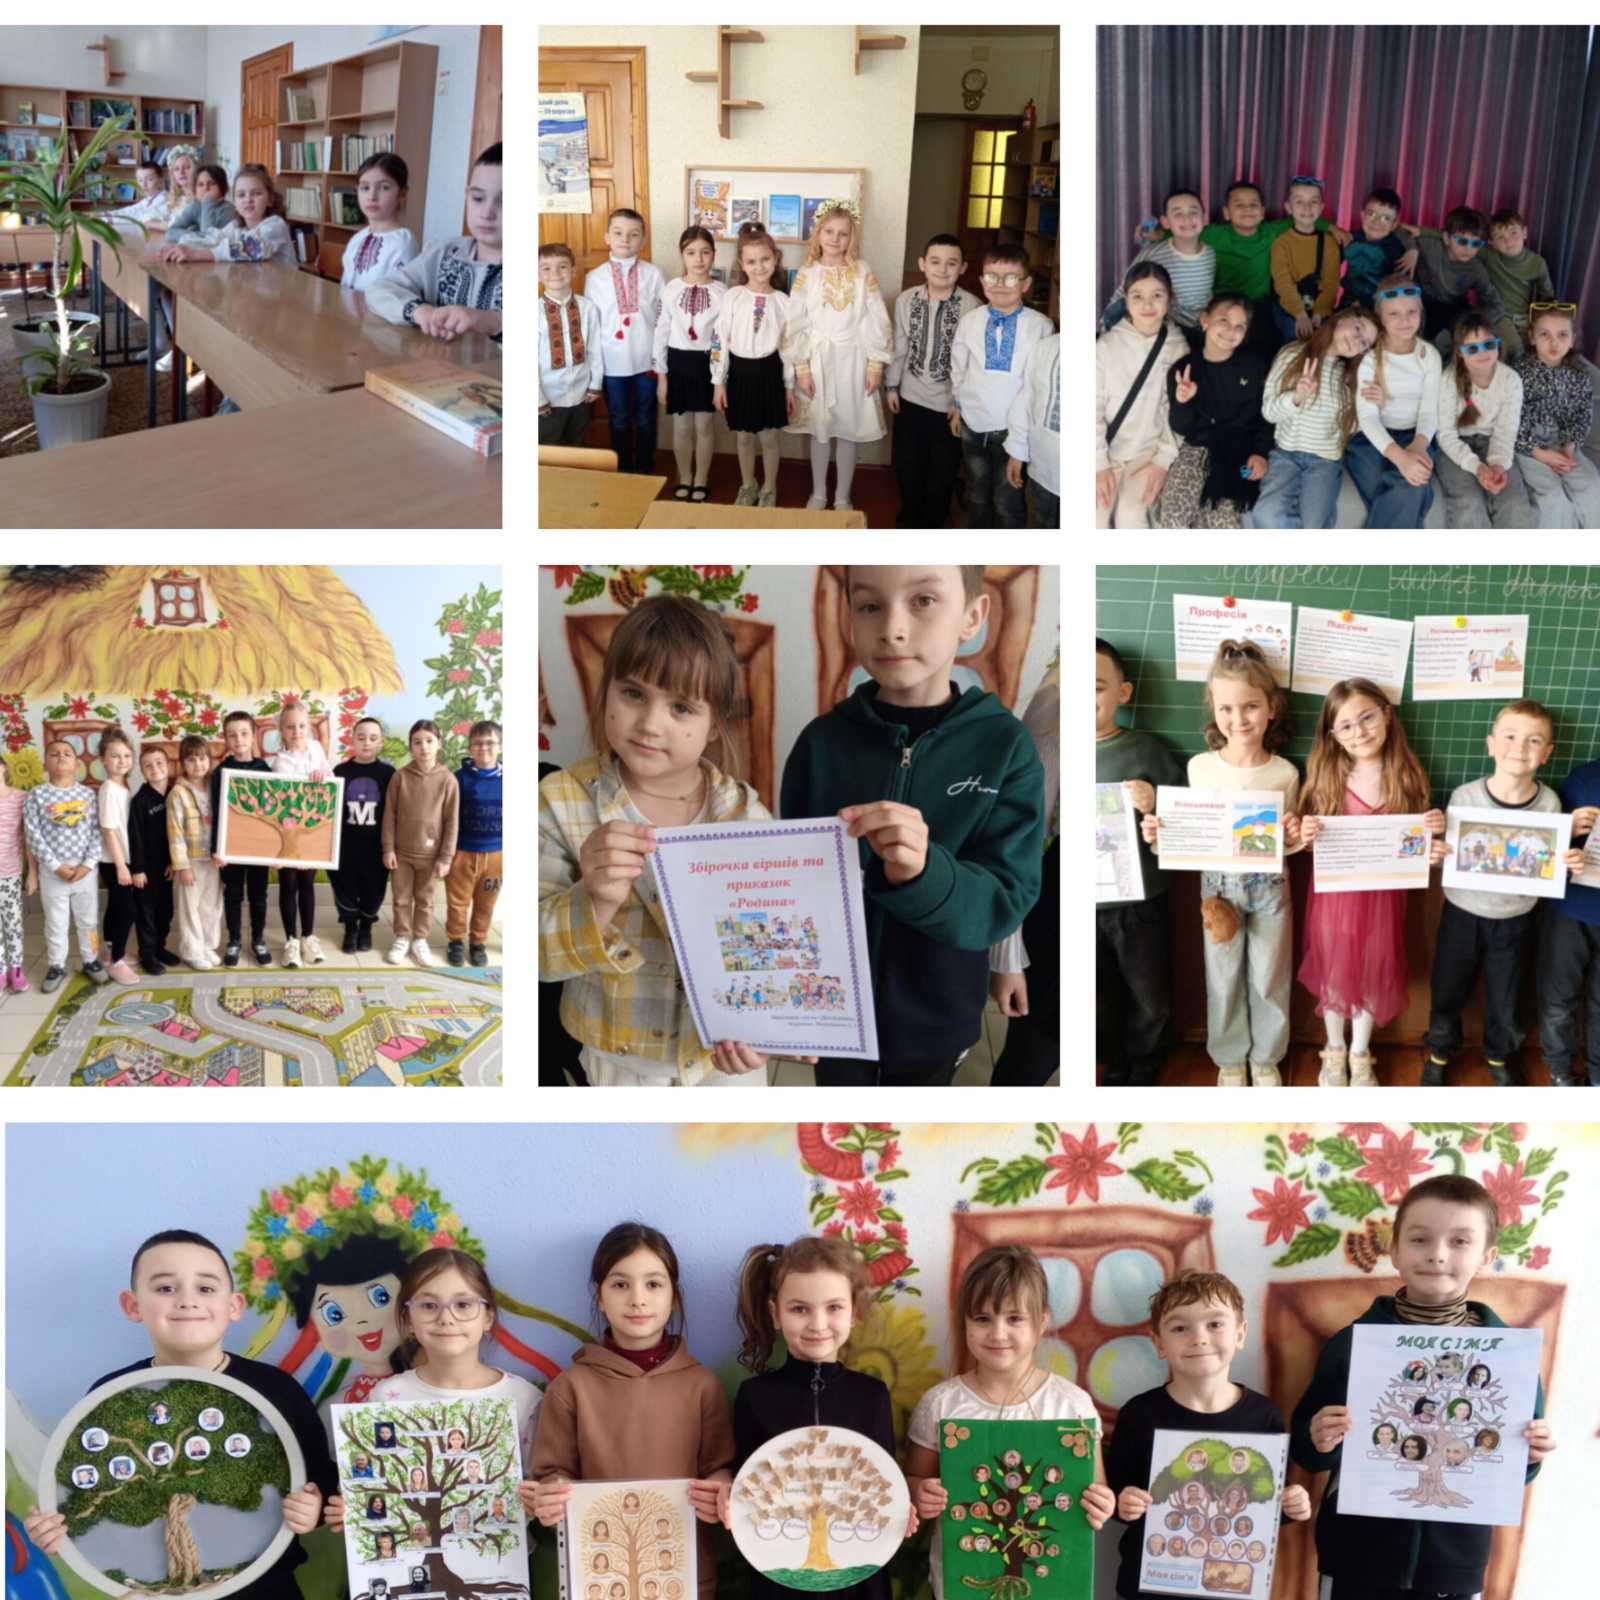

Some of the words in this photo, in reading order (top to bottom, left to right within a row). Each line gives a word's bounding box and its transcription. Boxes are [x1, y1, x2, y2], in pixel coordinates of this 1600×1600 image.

[1189, 606, 1247, 619] Професія
[347, 800, 378, 826] M
[687, 859, 749, 874] Збірочка
[752, 856, 799, 873] віршів
[803, 857, 824, 868] та
[727, 878, 791, 891] приказок
[729, 897, 796, 909] «Родина»
